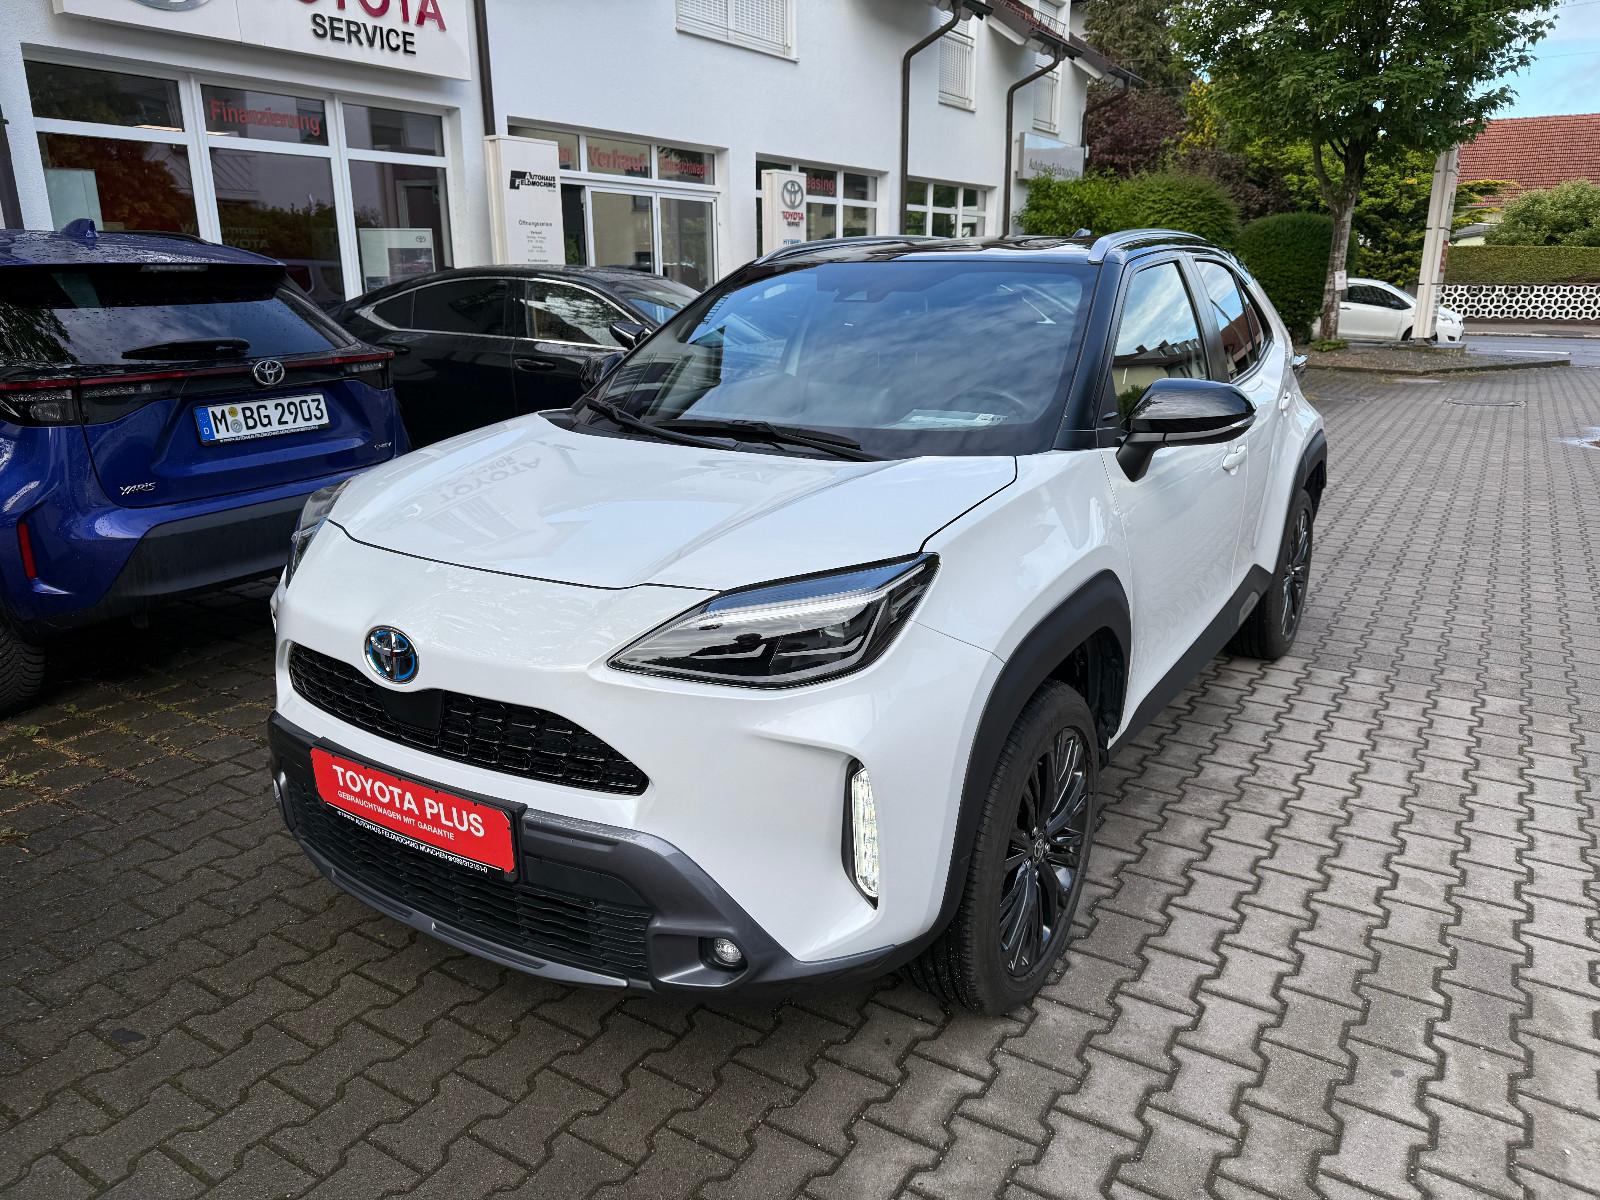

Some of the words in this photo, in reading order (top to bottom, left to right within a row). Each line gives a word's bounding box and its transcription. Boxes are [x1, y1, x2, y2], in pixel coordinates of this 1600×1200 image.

[311, 13, 416, 55] SERVICE
[210, 98, 320, 136] Finanzierung
[515, 180, 556, 189] FELDMOCHING
[525, 172, 556, 182] AUTOHAUS
[782, 211, 804, 221] TOYOTA
[211, 409, 229, 434] M
[241, 405, 272, 430] BG
[274, 398, 324, 425] 2903
[203, 427, 210, 435] D
[120, 481, 156, 495] YARIS
[332, 764, 419, 815] TOYOTA
[423, 797, 485, 837] PLUS
[337, 790, 402, 821] GEBRAUCHTWAGEN
[403, 815, 415, 827] MIT
[417, 821, 455, 841] GARANTIE
